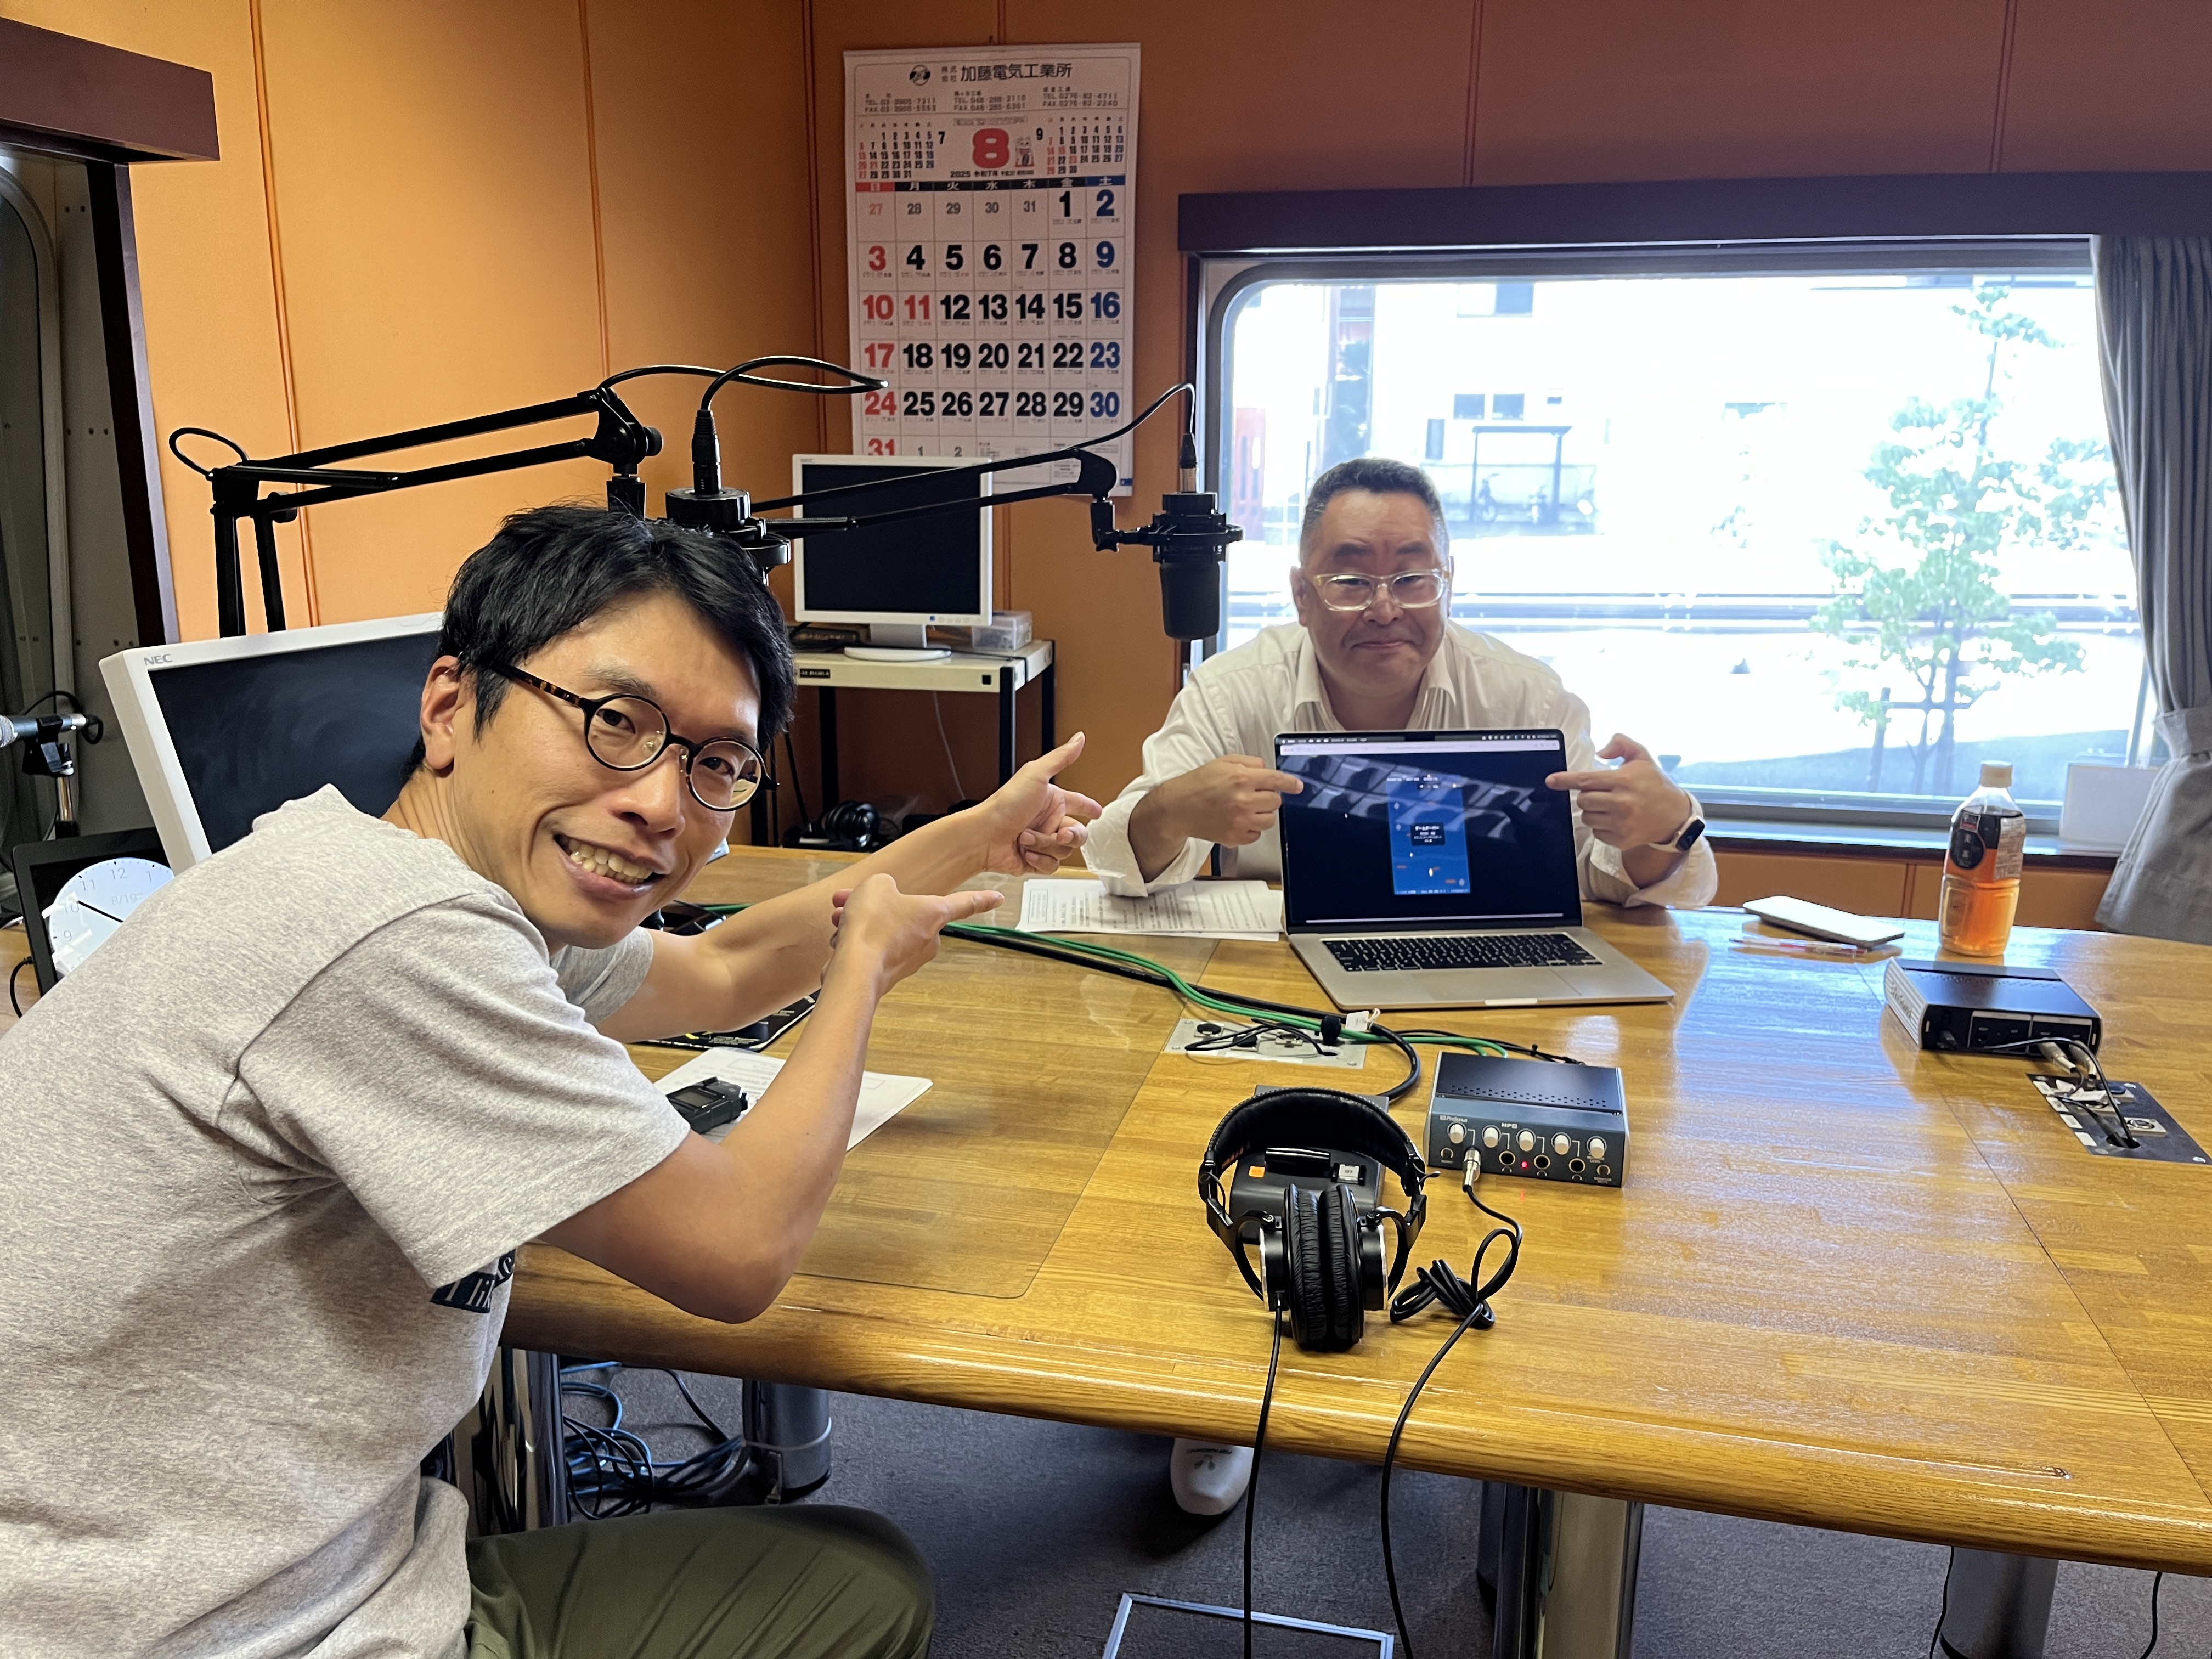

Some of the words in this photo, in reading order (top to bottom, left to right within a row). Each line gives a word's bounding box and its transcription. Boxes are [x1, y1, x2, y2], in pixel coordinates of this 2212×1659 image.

[961, 63, 1072, 82] 加藤電気工業所
[939, 131, 945, 144] 7
[1036, 128, 1043, 140] 9
[973, 128, 1009, 168] 8
[869, 203, 883, 215] 27
[907, 203, 921, 215] 28
[946, 202, 961, 214] 29
[985, 202, 999, 213] 30
[1024, 201, 1035, 212] 31
[1059, 191, 1070, 217] 1
[1097, 189, 1114, 216] 2
[869, 245, 886, 271] 3
[907, 245, 925, 270] 4
[946, 245, 963, 270] 5
[984, 245, 1001, 270] 6
[1022, 244, 1038, 269] 7
[1059, 242, 1076, 268] 8
[1096, 241, 1115, 268] 9
[863, 295, 894, 320] 10
[904, 295, 929, 319] 11
[940, 294, 970, 319] 12
[979, 294, 1007, 319] 13
[1015, 294, 1045, 319] 14
[1053, 293, 1082, 319] 15
[1091, 292, 1120, 318] 16
[865, 343, 894, 368] 17
[903, 343, 933, 368] 18
[941, 343, 971, 368] 19
[979, 343, 1009, 368] 20
[1018, 343, 1044, 368] 21
[1053, 343, 1083, 368] 22
[1090, 342, 1120, 368] 23
[864, 391, 897, 415] 24
[904, 391, 935, 416] 25
[942, 392, 973, 416] 26
[980, 392, 1009, 416] 27
[1017, 392, 1046, 417] 28
[1054, 392, 1084, 417] 29
[1090, 392, 1119, 417] 30
[868, 438, 894, 455] 31
[917, 446, 923, 456] 1
[954, 447, 962, 457] 2
[144, 654, 173, 665] NEC
[109, 867, 127, 879] 12
[145, 871, 151, 882] 1
[80, 879, 95, 891] 11
[63, 930, 72, 942] 9
